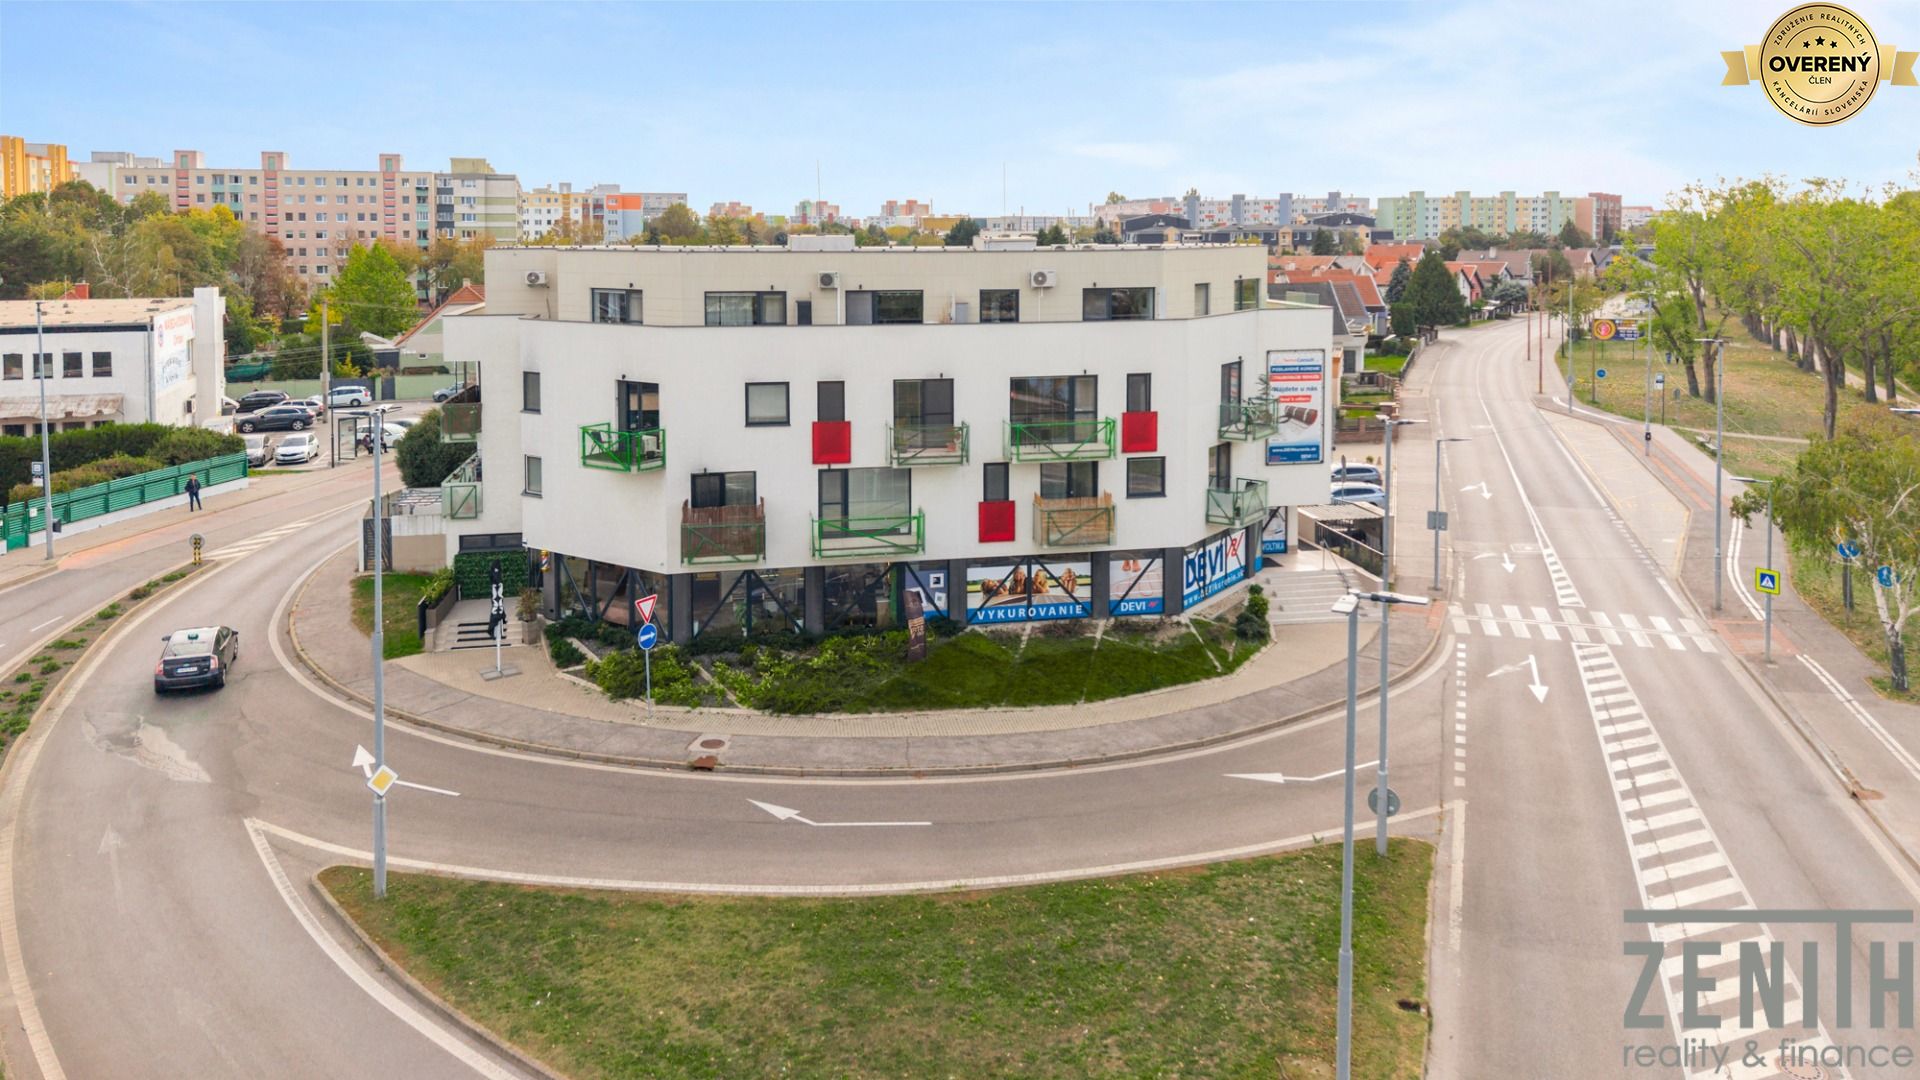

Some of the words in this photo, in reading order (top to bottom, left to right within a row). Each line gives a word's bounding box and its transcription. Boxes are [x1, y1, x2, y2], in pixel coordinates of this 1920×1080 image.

[1185, 542, 1224, 590] DEVI
[976, 604, 1083, 620] VYKUROVANIE
[1120, 602, 1146, 612] DEVI
